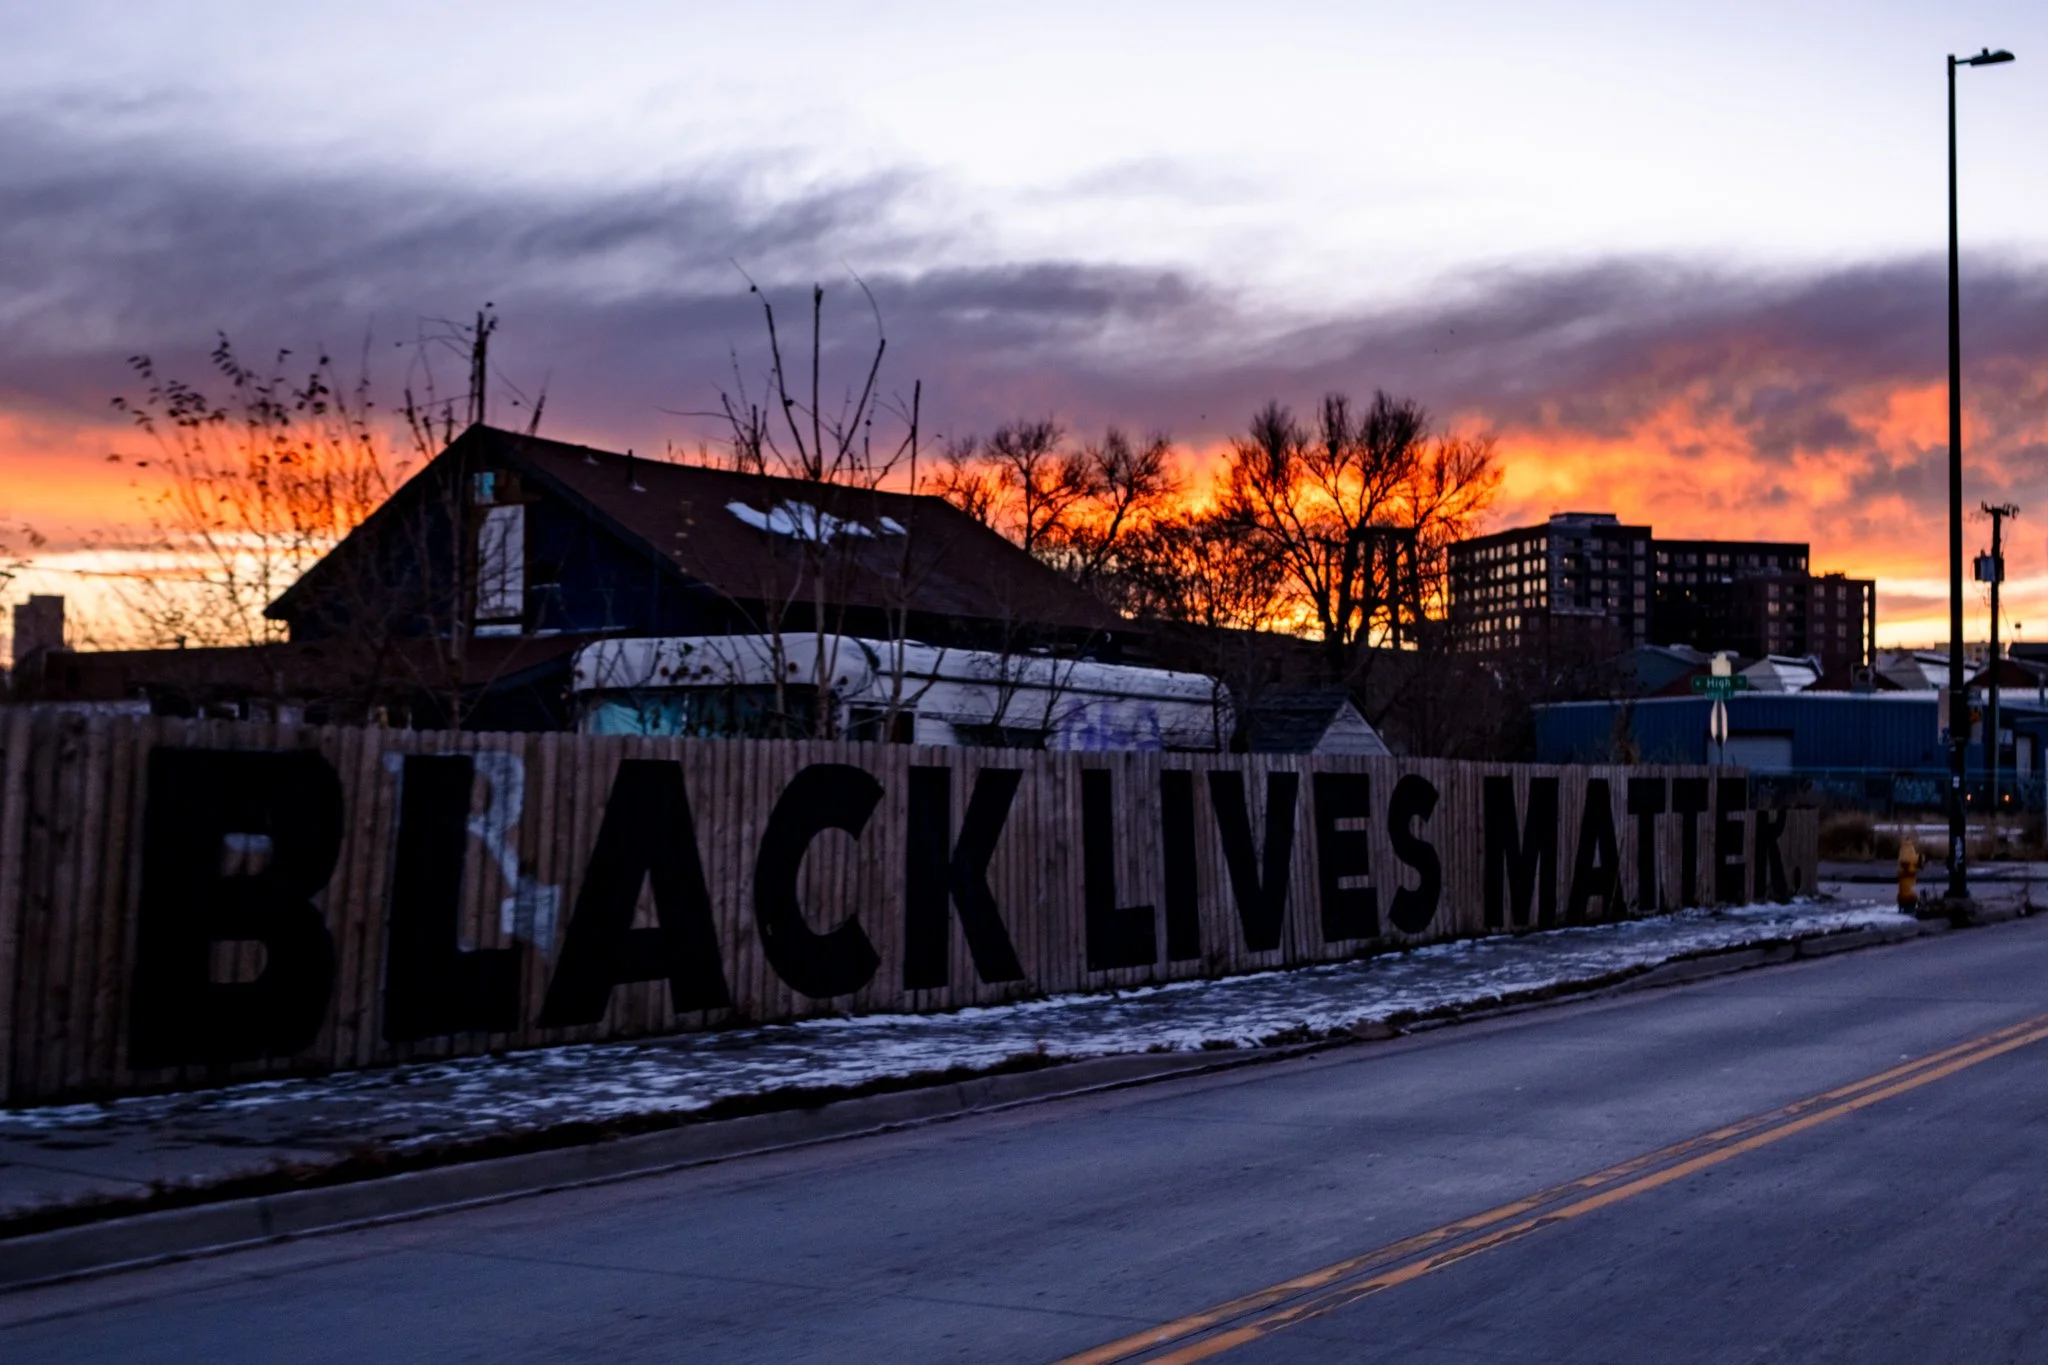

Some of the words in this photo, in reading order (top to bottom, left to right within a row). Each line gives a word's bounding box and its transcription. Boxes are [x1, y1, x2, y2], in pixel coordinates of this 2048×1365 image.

[1706, 678, 1731, 689] High
[127, 747, 1025, 1070] BLACK
[1082, 768, 1441, 972] LIVES
